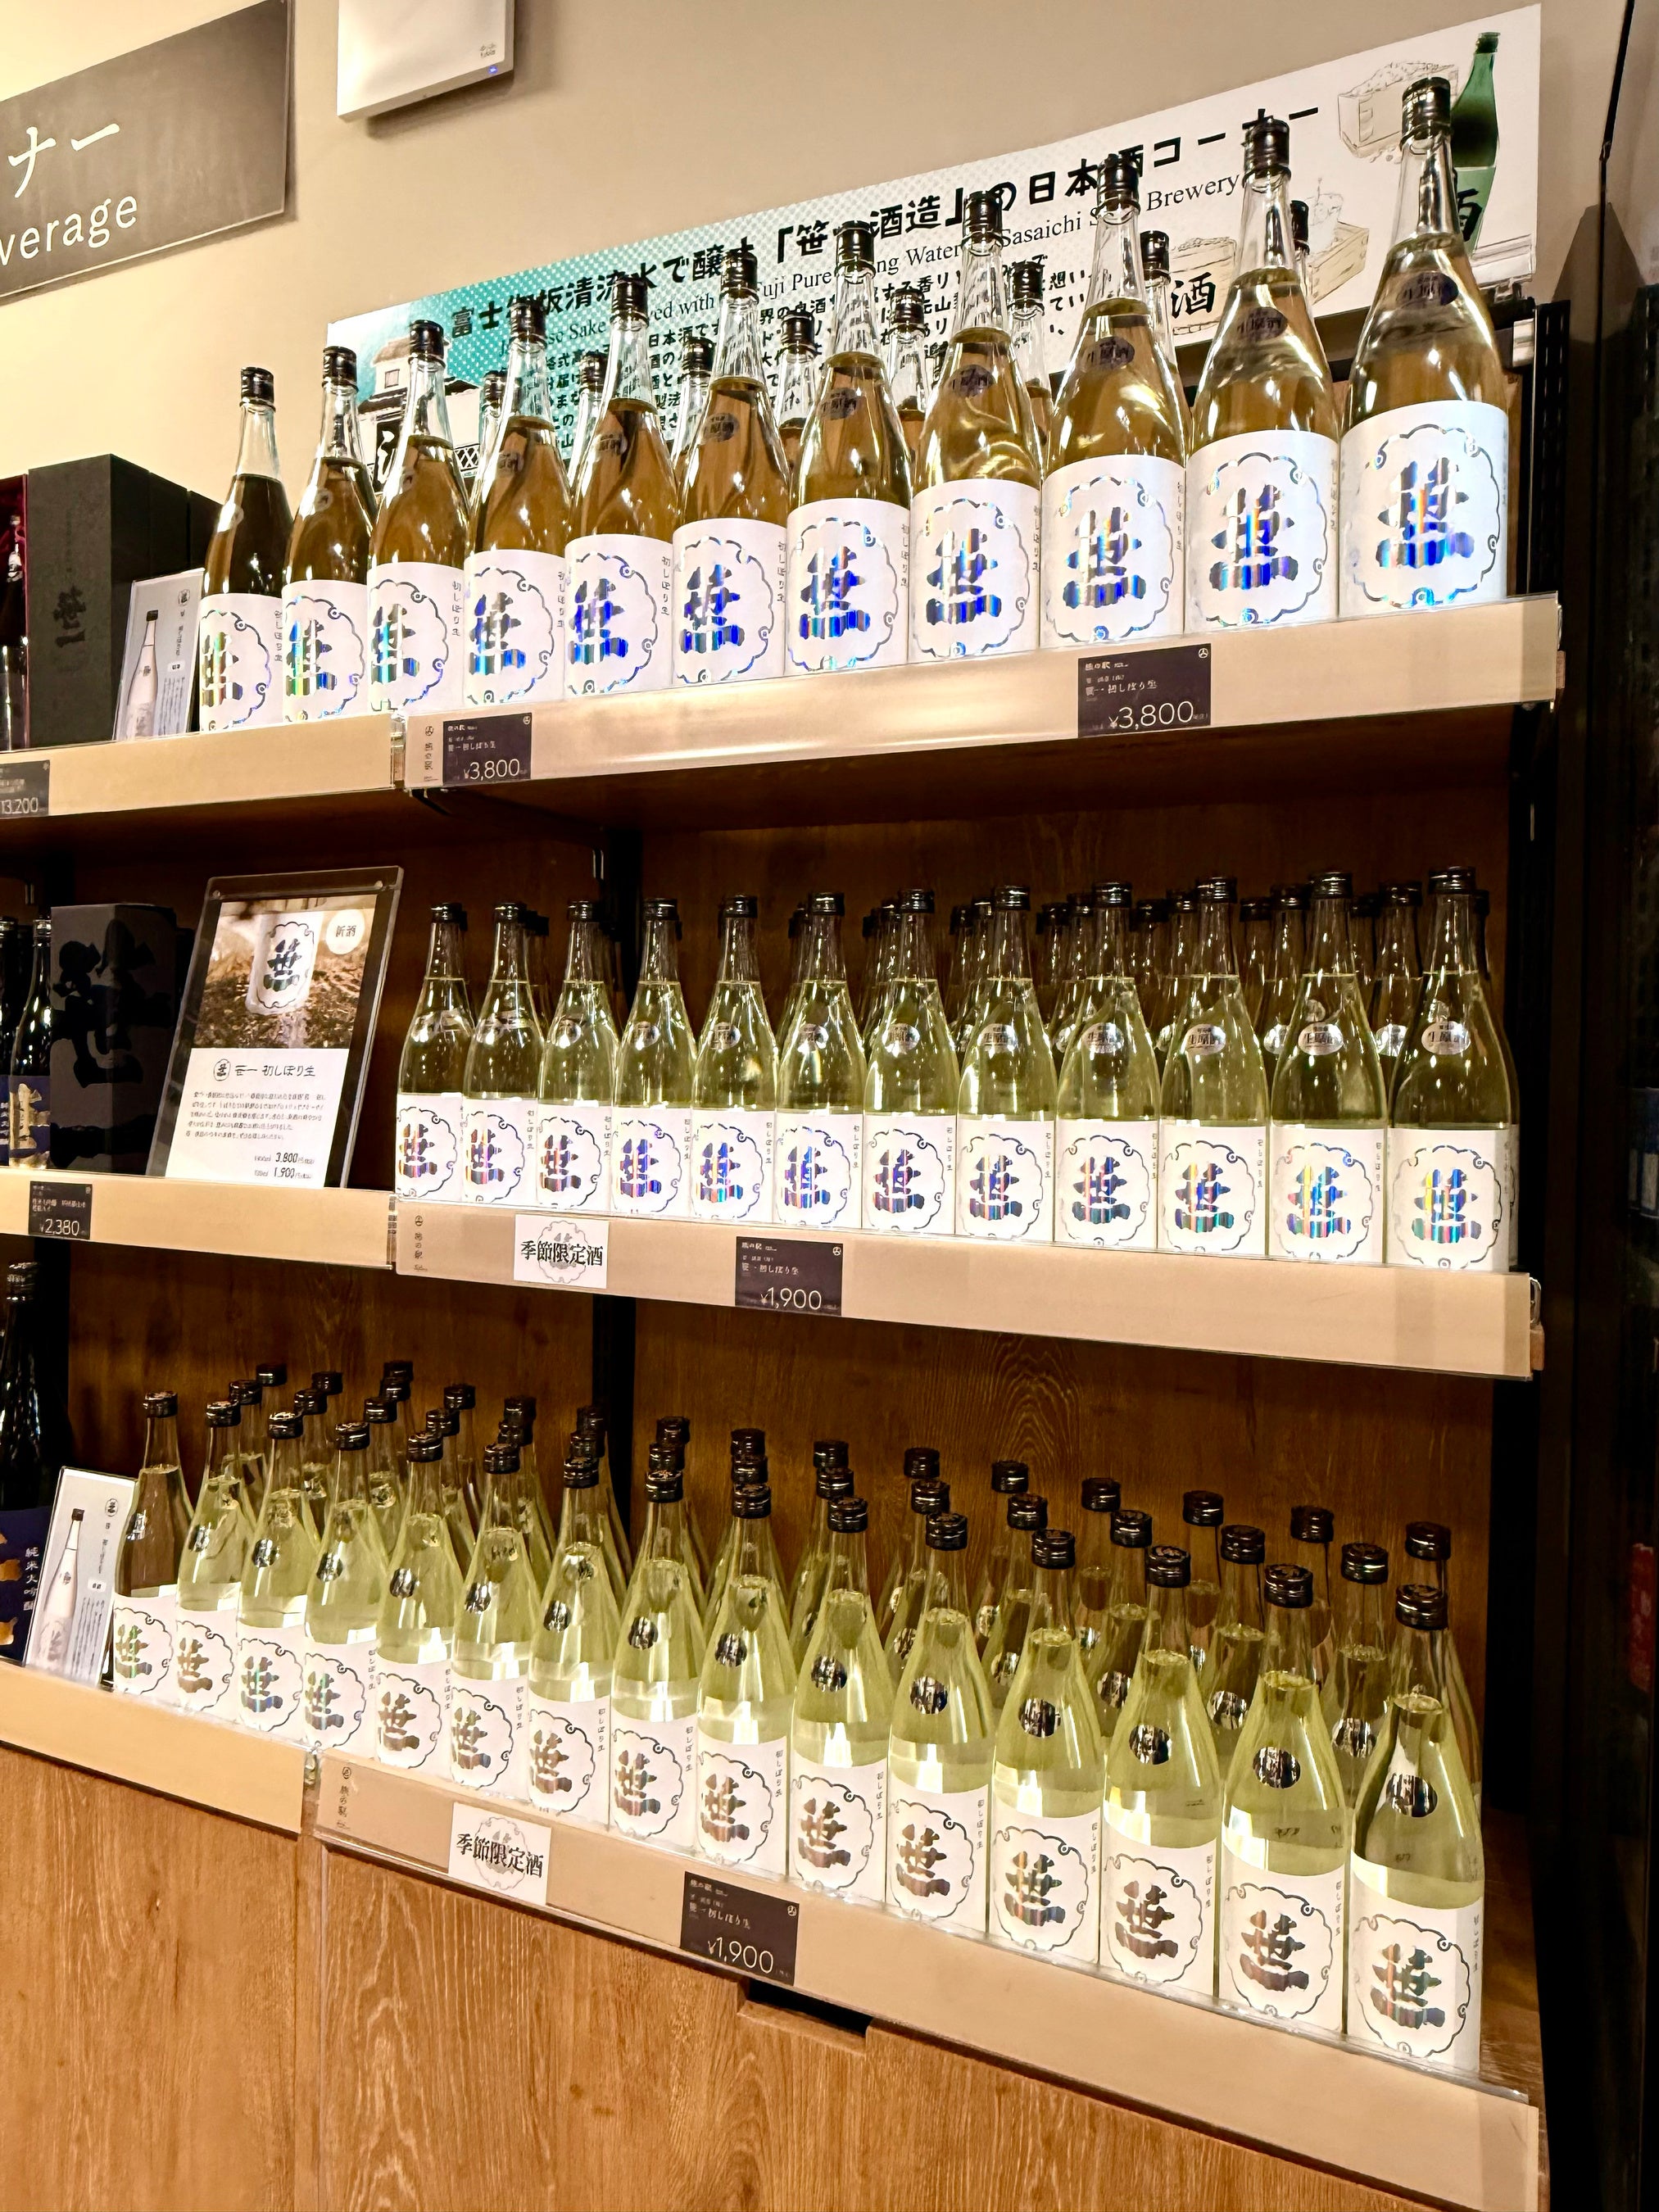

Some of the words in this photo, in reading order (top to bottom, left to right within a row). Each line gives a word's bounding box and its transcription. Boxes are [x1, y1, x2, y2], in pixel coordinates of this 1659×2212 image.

[8, 124, 120, 197] ナー
[569, 319, 607, 342] Sake
[678, 292, 714, 316] with
[792, 271, 832, 292] Pure
[905, 243, 959, 267] Water
[1000, 211, 1082, 248] Sasaichi
[1147, 173, 1242, 212] Brewery
[1172, 271, 1214, 320] 酒
[1108, 700, 1194, 730] ¥3,800
[464, 759, 520, 781] ¥3,800
[521, 1240, 603, 1267] 季節限定酒
[760, 1286, 822, 1310] ¥1,900
[456, 1832, 543, 1878] 季節限定酒
[708, 1937, 774, 1974] ¥1,900
